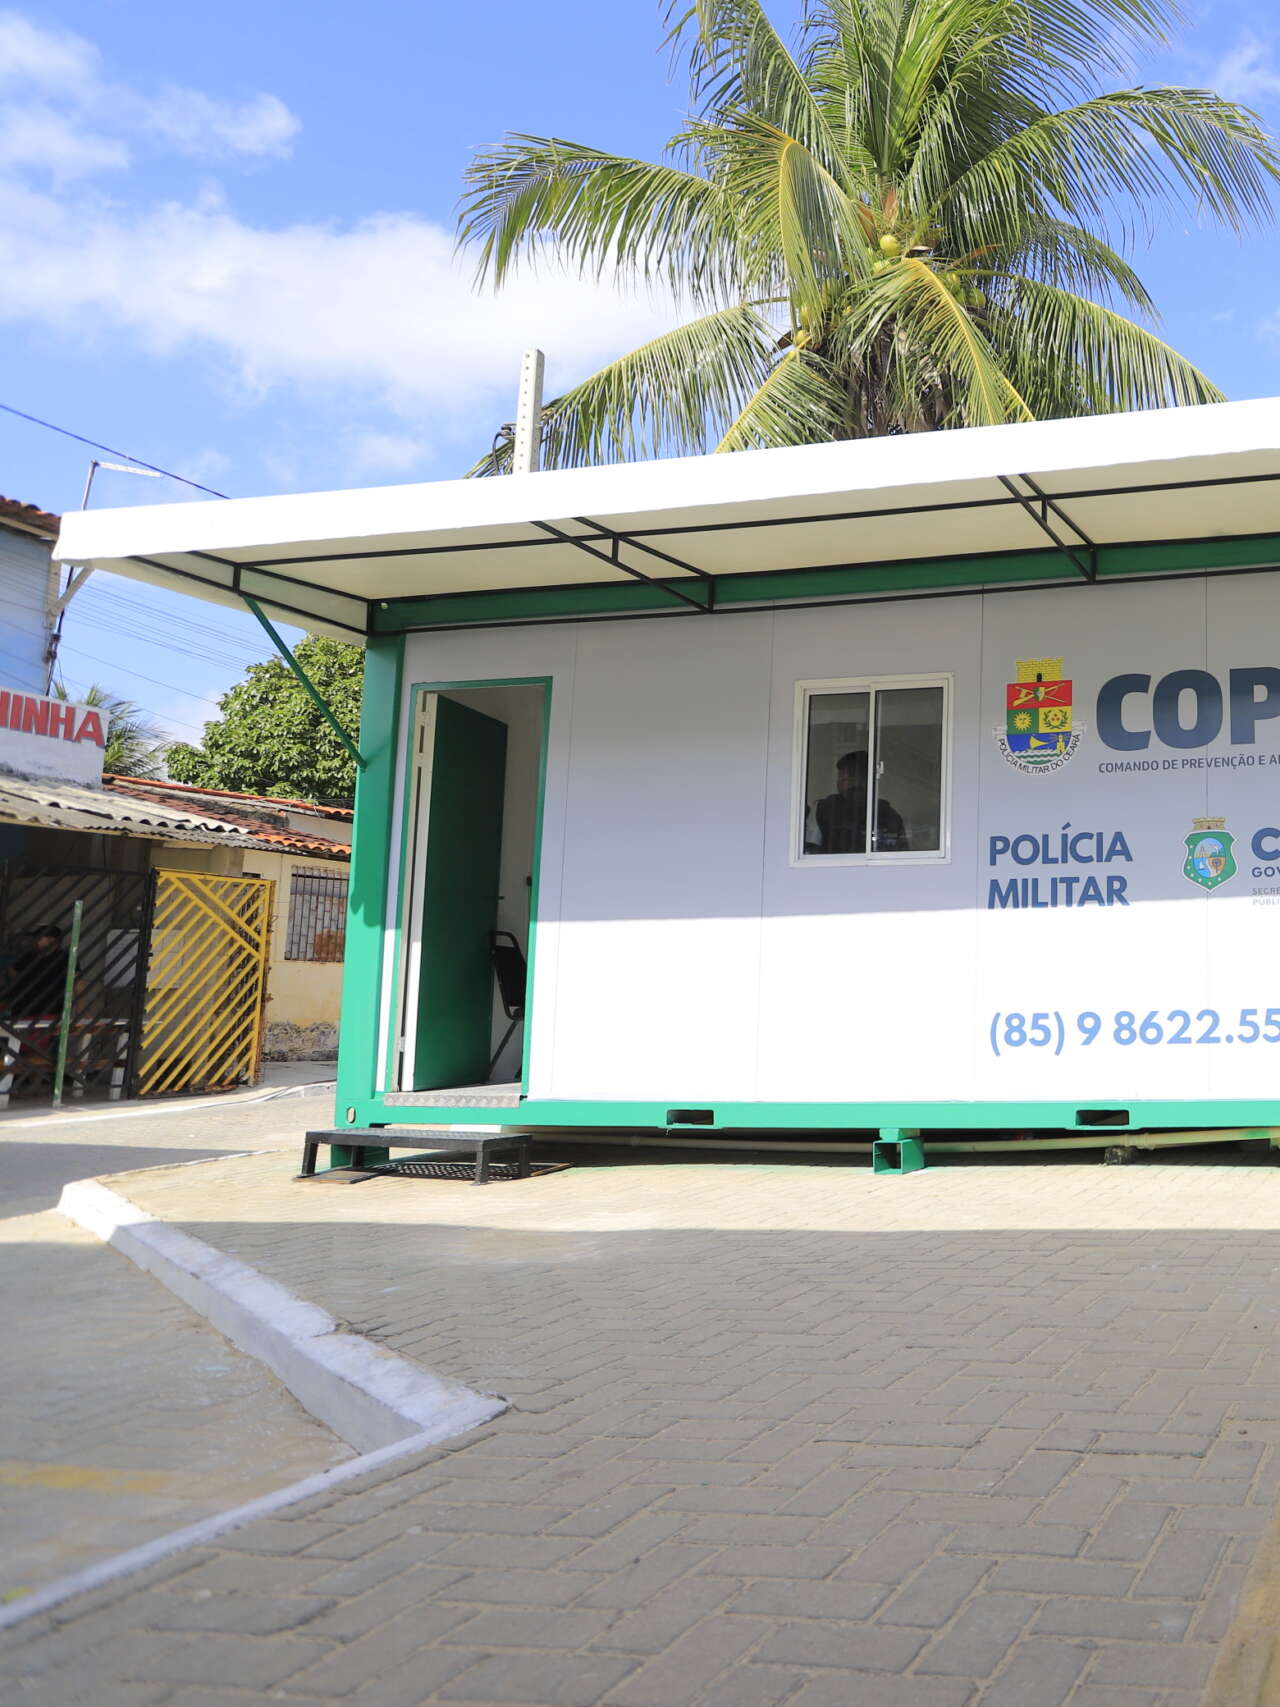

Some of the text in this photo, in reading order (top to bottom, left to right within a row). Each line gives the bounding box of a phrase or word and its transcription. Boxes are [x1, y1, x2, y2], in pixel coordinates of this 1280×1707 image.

[1098, 760, 1159, 774] COMANDO
[1162, 759, 1178, 770] DE
[1181, 753, 1255, 770] PREVENÇÃO
[1258, 754, 1266, 766] E
[989, 822, 1133, 866] POLÍCIA
[987, 875, 1130, 909] MILITAR
[990, 1010, 1065, 1056] (85)
[1076, 1011, 1102, 1046] 9
